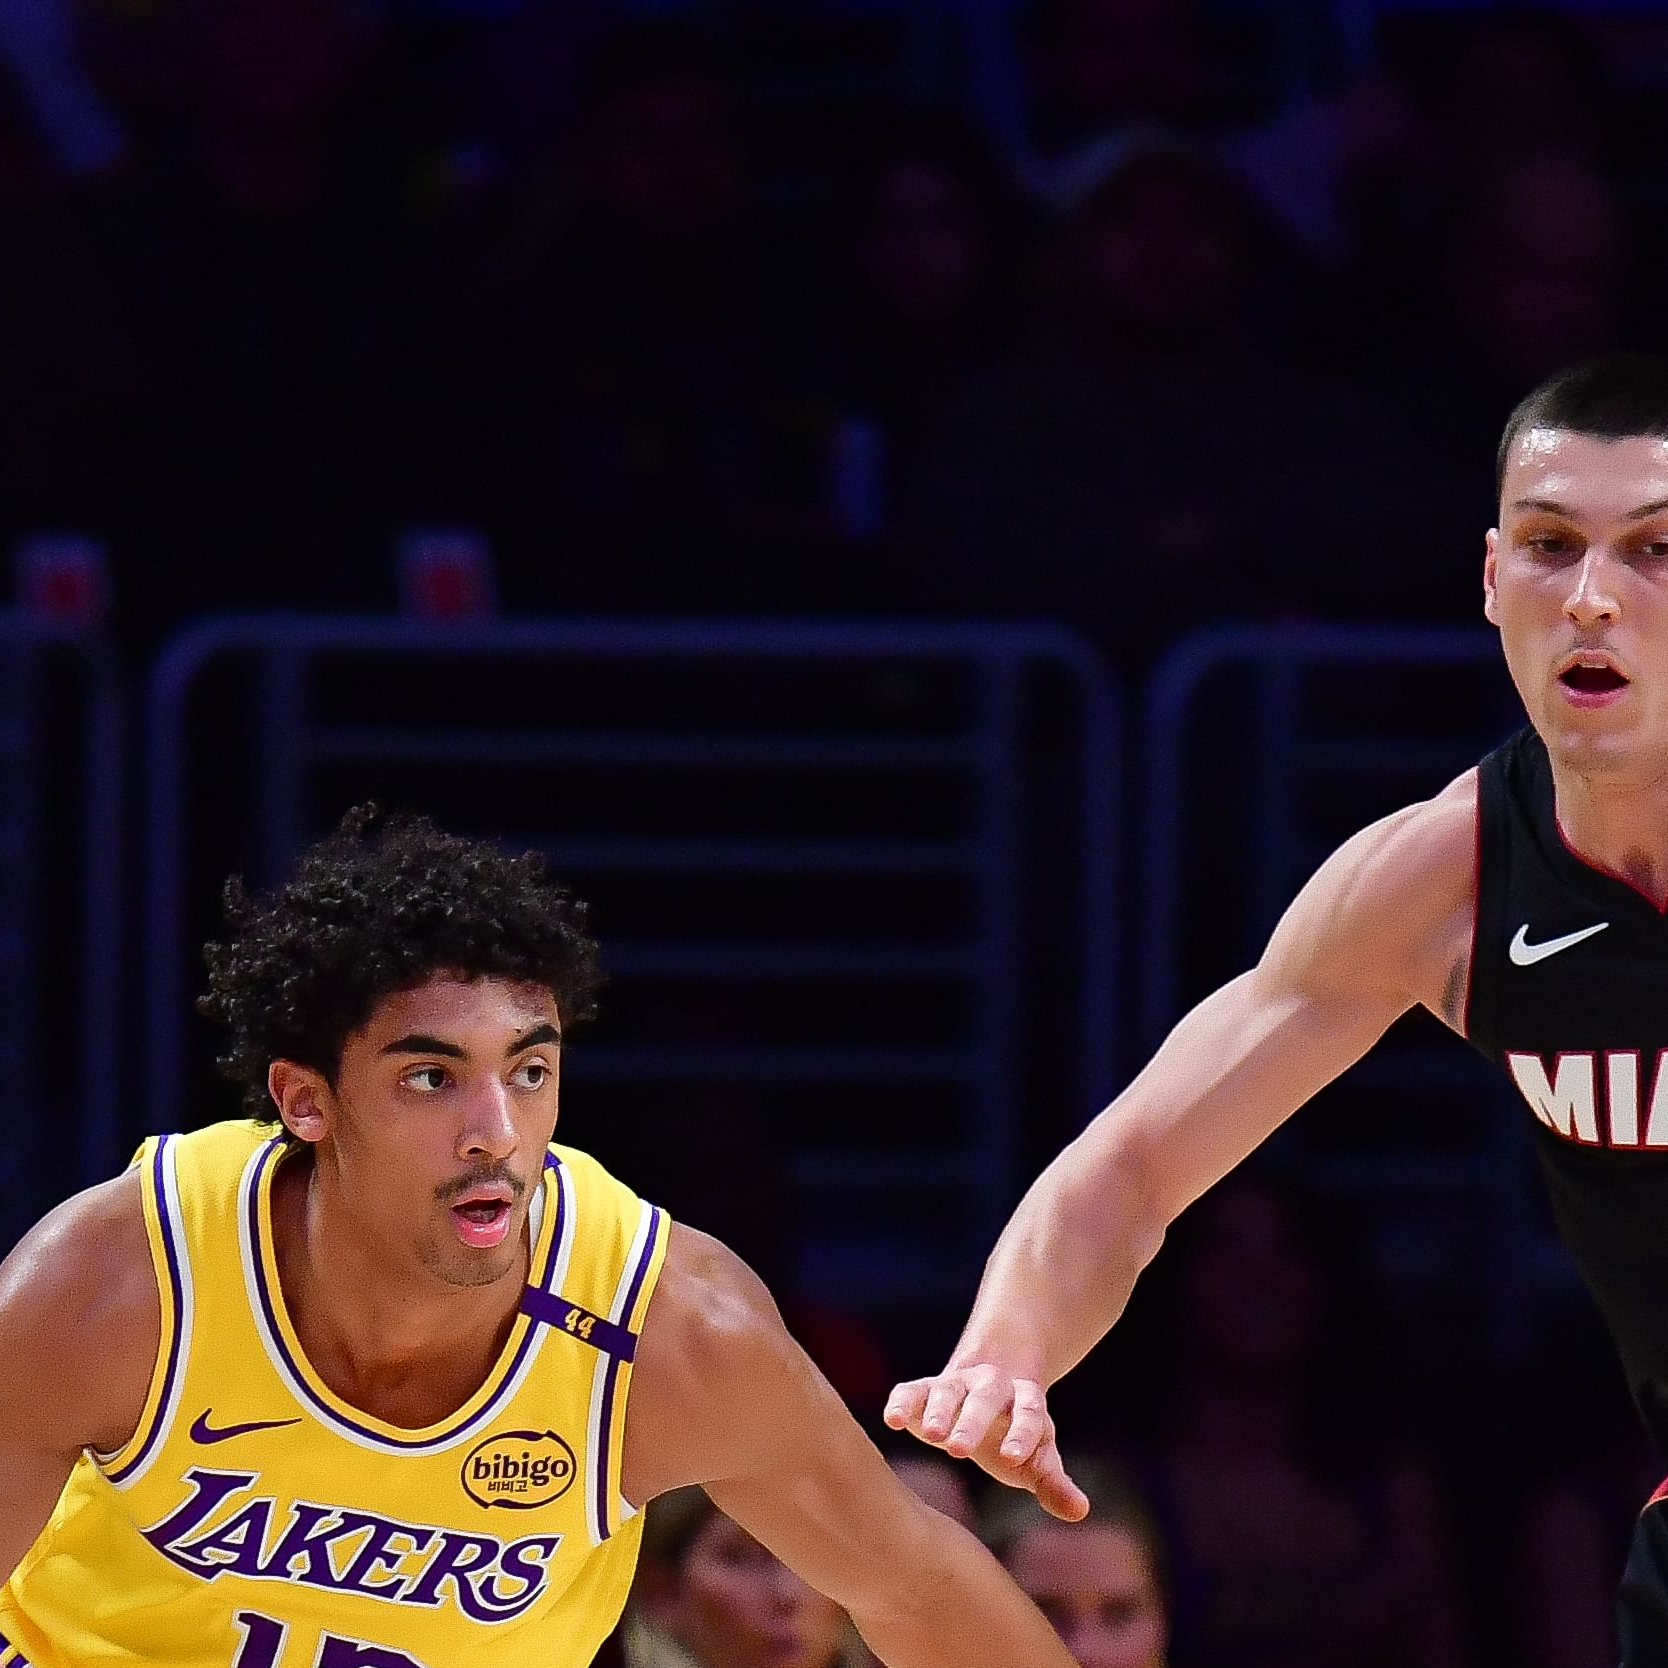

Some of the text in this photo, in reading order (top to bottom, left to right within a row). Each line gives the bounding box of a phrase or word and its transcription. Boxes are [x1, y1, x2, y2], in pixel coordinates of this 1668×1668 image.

[564, 1308, 596, 1341] 44
[473, 1452, 569, 1487] bibigo
[487, 1480, 528, 1493] 비비고
[142, 1467, 561, 1625] LAKERS
